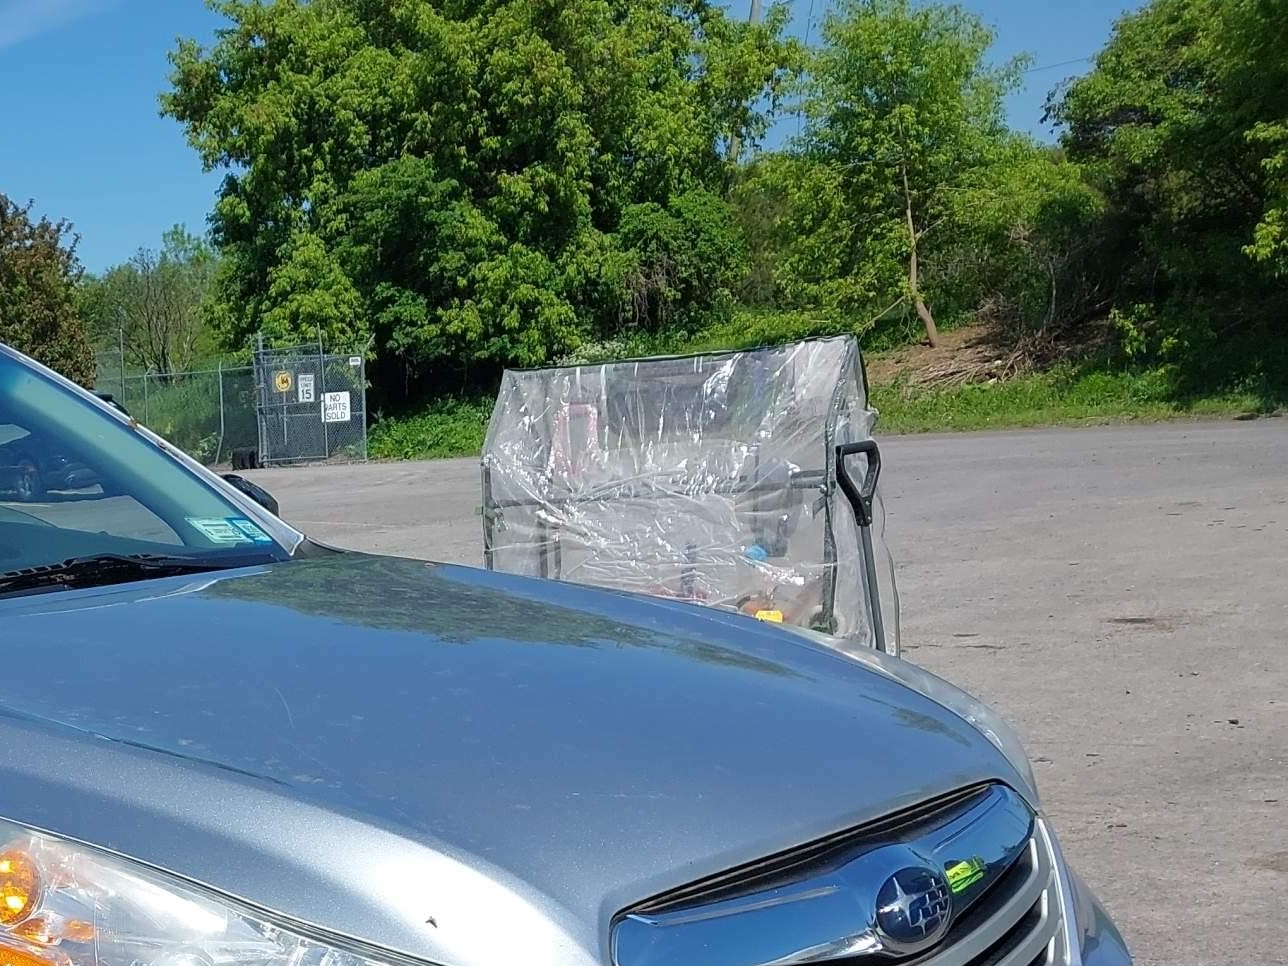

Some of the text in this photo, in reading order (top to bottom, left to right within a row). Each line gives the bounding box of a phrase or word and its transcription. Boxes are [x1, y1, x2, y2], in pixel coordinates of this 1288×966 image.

[301, 388, 312, 400] 15
[329, 393, 341, 402] NO
[326, 411, 346, 421] SOLD
